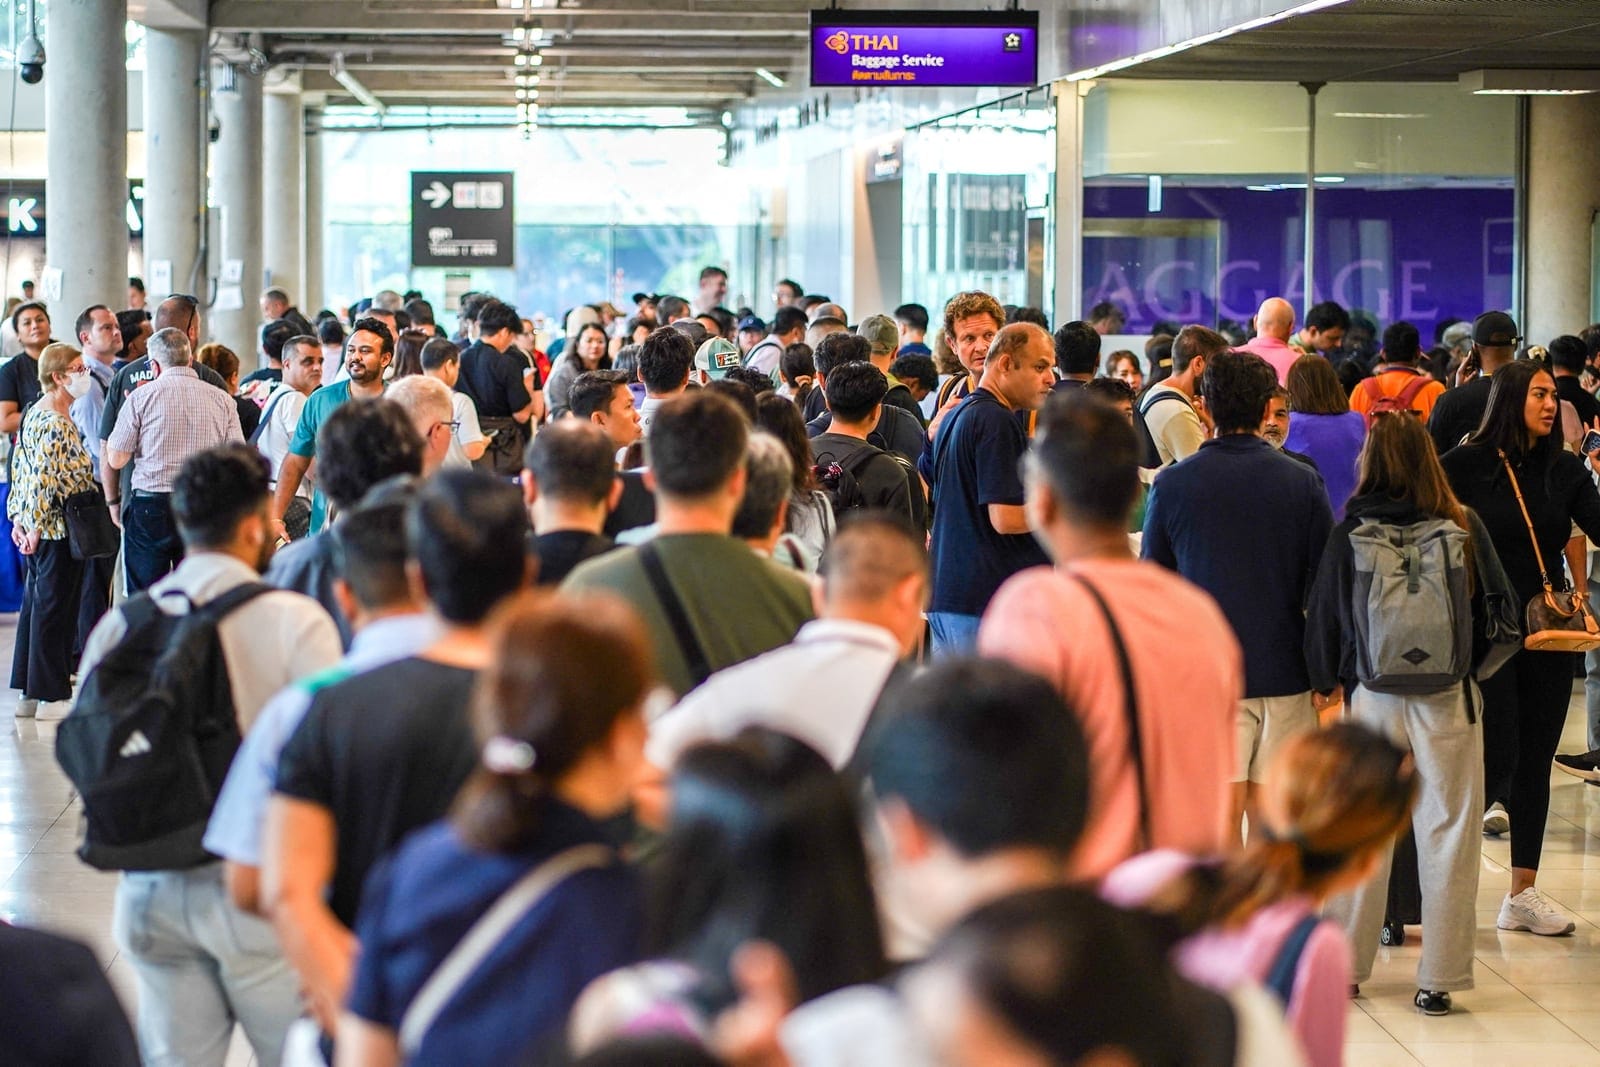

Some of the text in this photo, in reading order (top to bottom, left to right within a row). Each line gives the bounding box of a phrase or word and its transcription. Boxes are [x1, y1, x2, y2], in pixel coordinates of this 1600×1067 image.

[851, 34, 898, 50] THAI
[851, 53, 944, 69] Baggage Service
[1092, 260, 1440, 322] AGGAGE
